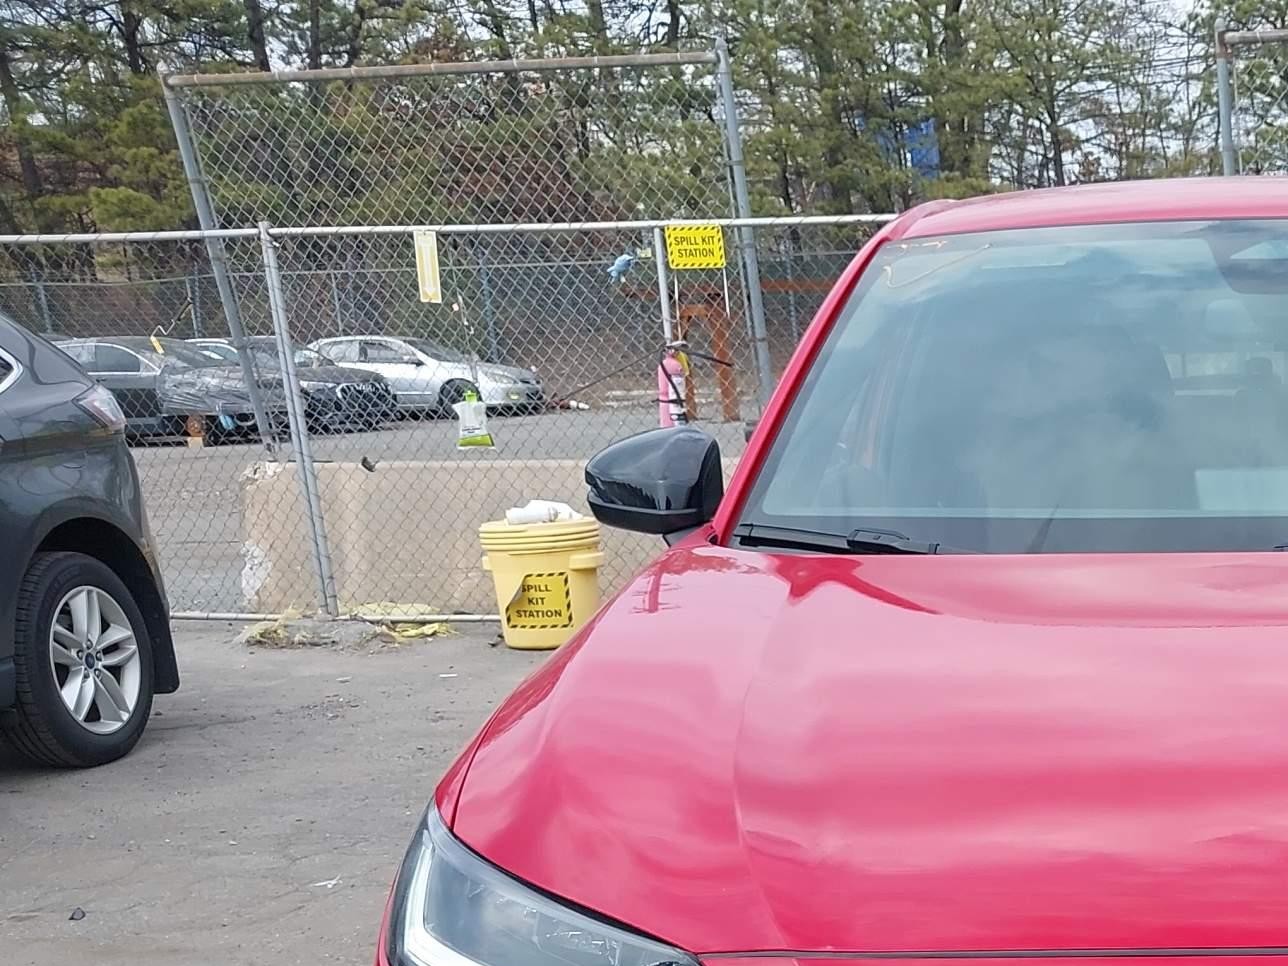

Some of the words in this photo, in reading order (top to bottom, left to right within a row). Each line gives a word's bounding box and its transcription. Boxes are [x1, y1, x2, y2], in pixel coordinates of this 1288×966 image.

[674, 236, 699, 246] SPILL
[701, 235, 715, 245] KIT
[678, 248, 714, 258] STATION
[521, 584, 552, 593] SPILL
[527, 597, 546, 606] KIT
[515, 609, 562, 619] STATION
